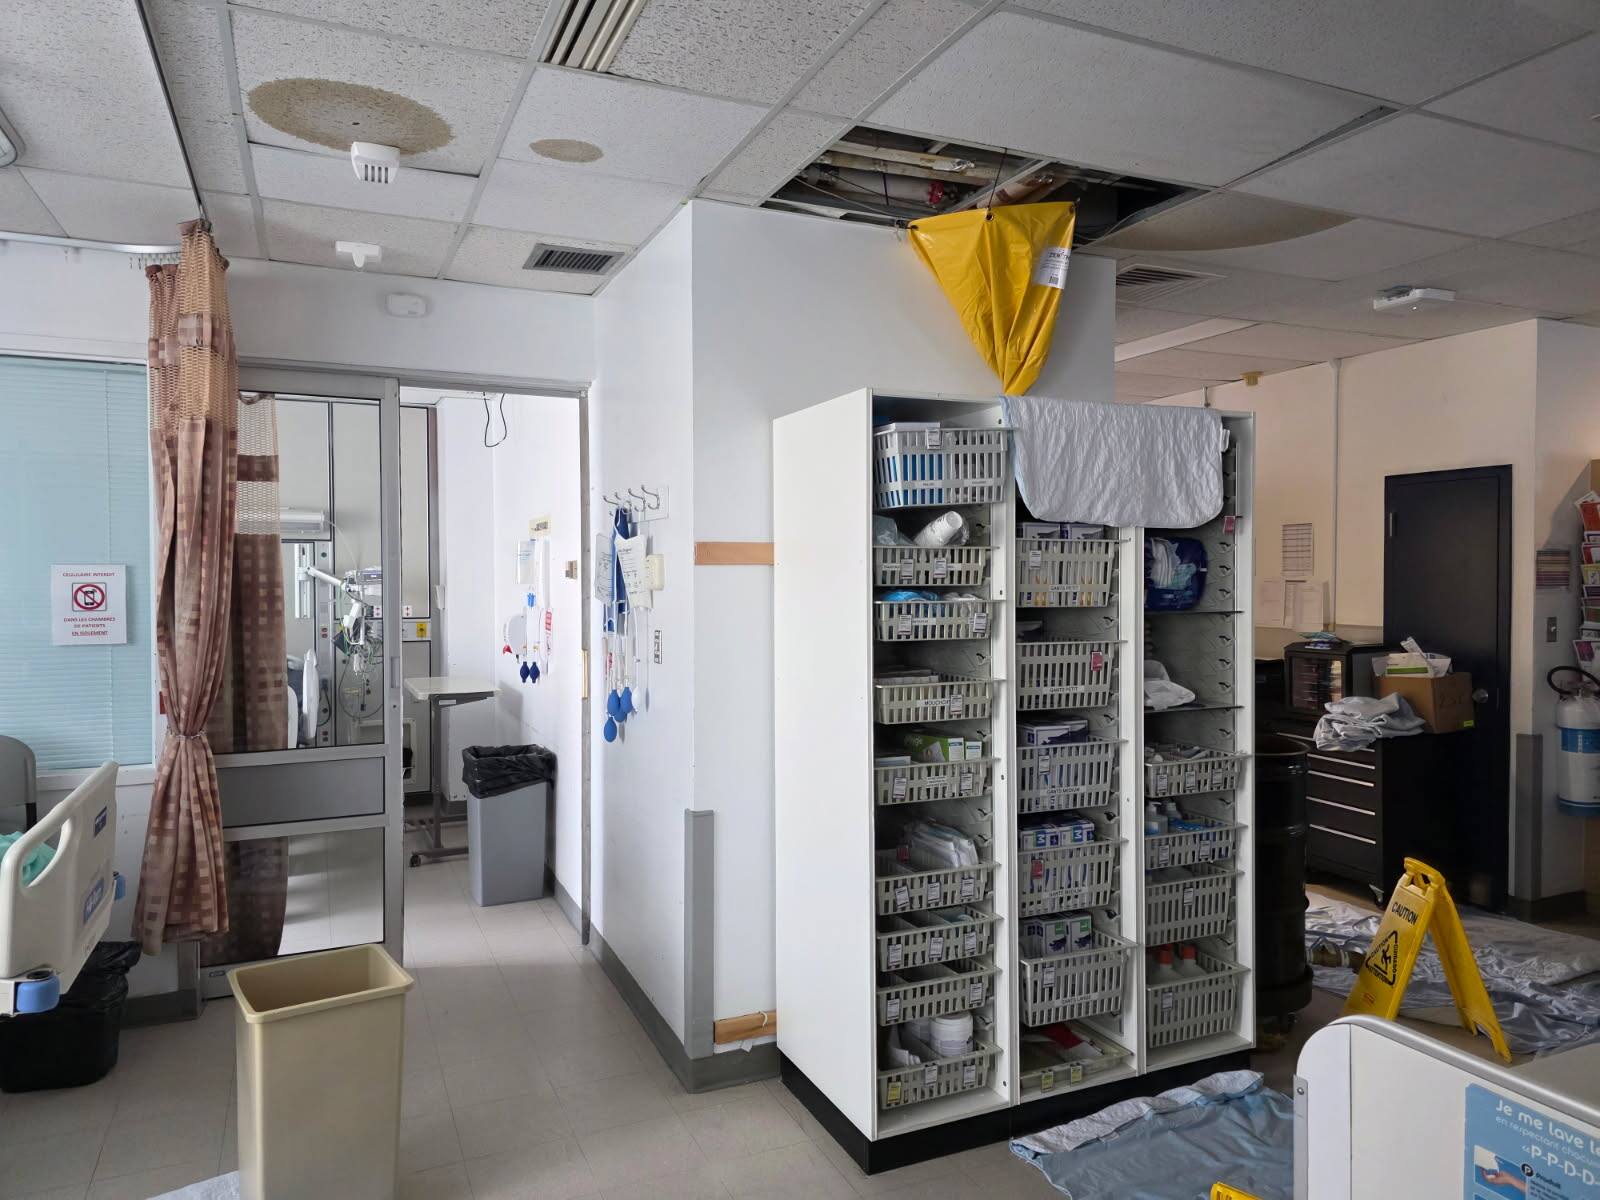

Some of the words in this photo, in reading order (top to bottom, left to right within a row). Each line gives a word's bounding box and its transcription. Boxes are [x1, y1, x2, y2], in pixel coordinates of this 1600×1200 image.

[1392, 901, 1419, 926] CAUTION
[1495, 1099, 1513, 1116] Je
[1518, 1112, 1544, 1130] me
[1549, 1121, 1584, 1149] lave
